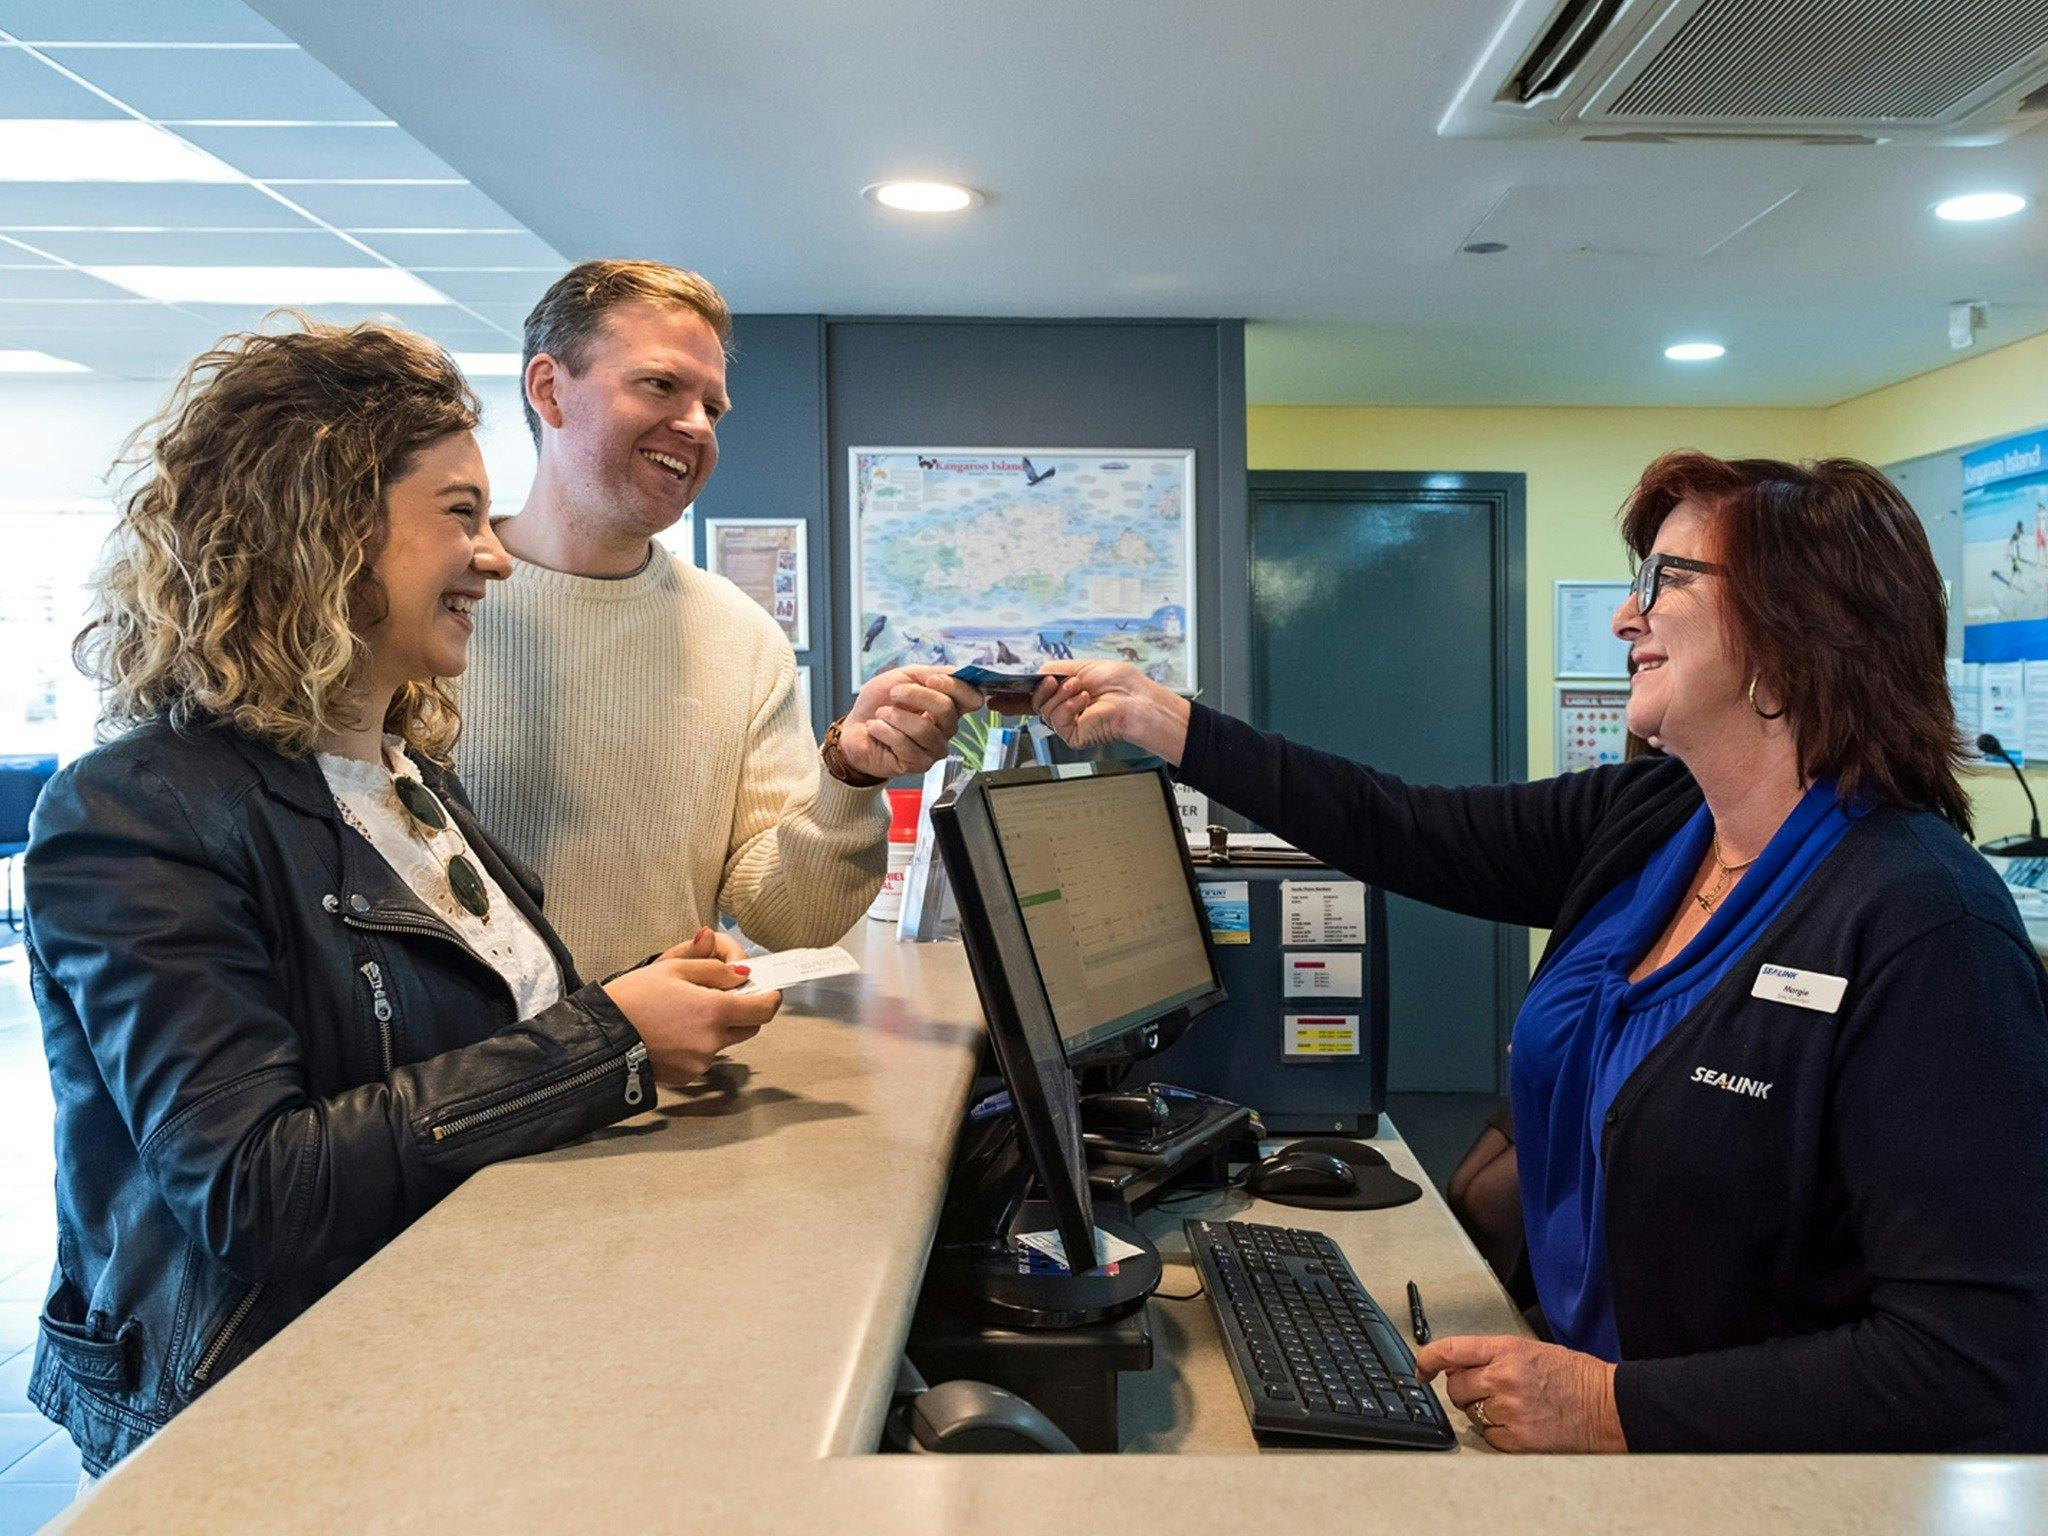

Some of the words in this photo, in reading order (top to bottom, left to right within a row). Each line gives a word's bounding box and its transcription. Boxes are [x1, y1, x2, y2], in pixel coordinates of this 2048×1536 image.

[935, 461, 989, 473] Kangaroo
[992, 460, 1024, 472] Island
[2004, 444, 2041, 474] Island
[1762, 966, 1797, 980] SEALINK
[1690, 1066, 1774, 1100] SEALINK
